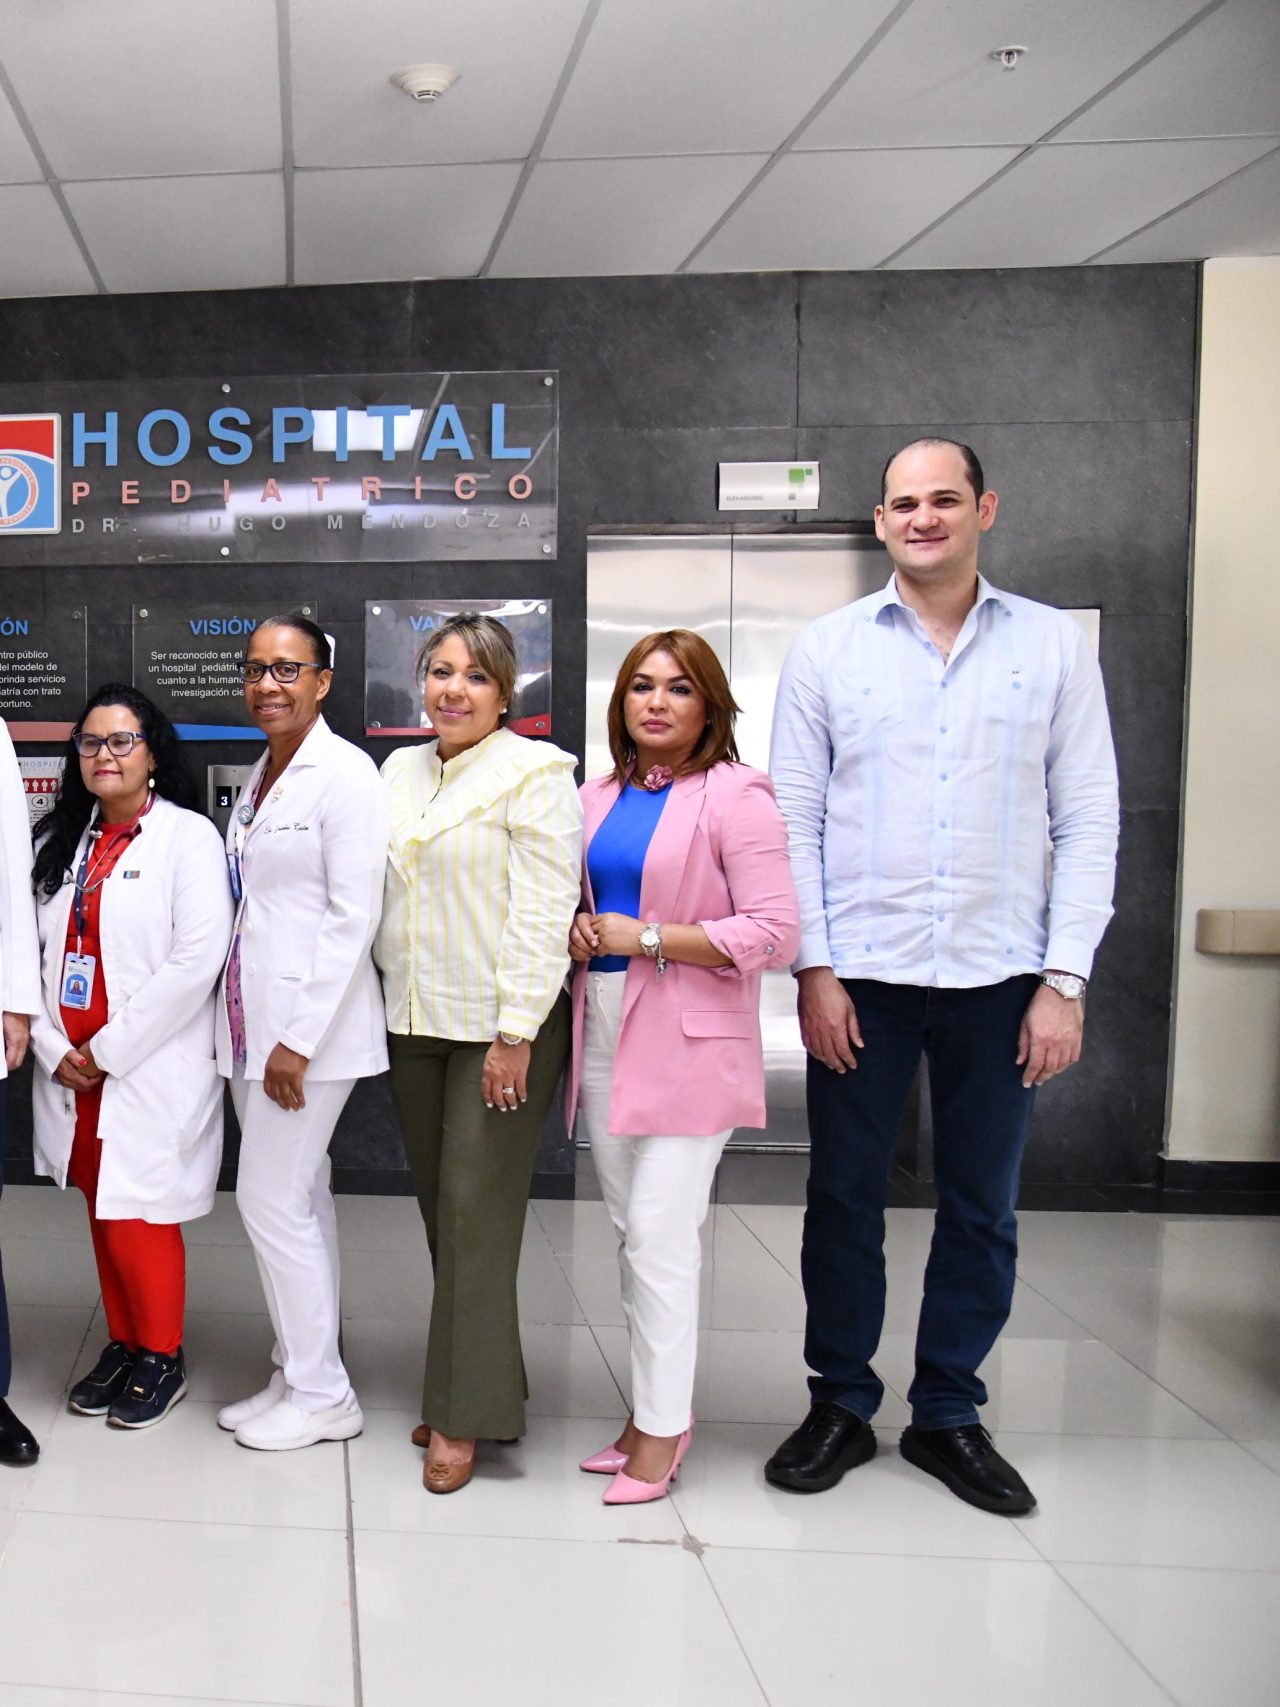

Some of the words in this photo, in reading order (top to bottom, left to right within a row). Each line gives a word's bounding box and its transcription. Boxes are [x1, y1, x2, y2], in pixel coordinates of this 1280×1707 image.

[72, 402, 532, 467] HOSPITAL
[72, 473, 533, 506] PEDIATRICO
[176, 514, 286, 534] HUGO
[326, 512, 532, 531] MENDOZA
[189, 615, 257, 636] VISIÓN
[17, 649, 49, 661] público
[150, 651, 166, 660] Ser
[169, 650, 218, 660] reconocido
[220, 651, 232, 659] en
[234, 650, 243, 659] el
[11, 662, 44, 672] modelo
[46, 662, 58, 671] de
[148, 664, 160, 673] un
[161, 663, 197, 674] hospital
[201, 662, 240, 674] pediátric
[27, 674, 66, 683] servicios
[156, 676, 187, 685] cuanto
[189, 677, 196, 685] a
[198, 675, 206, 684] la
[23, 687, 39, 696] con
[41, 687, 61, 696] trato
[171, 687, 229, 698] investigación
[220, 796, 228, 806] 3
